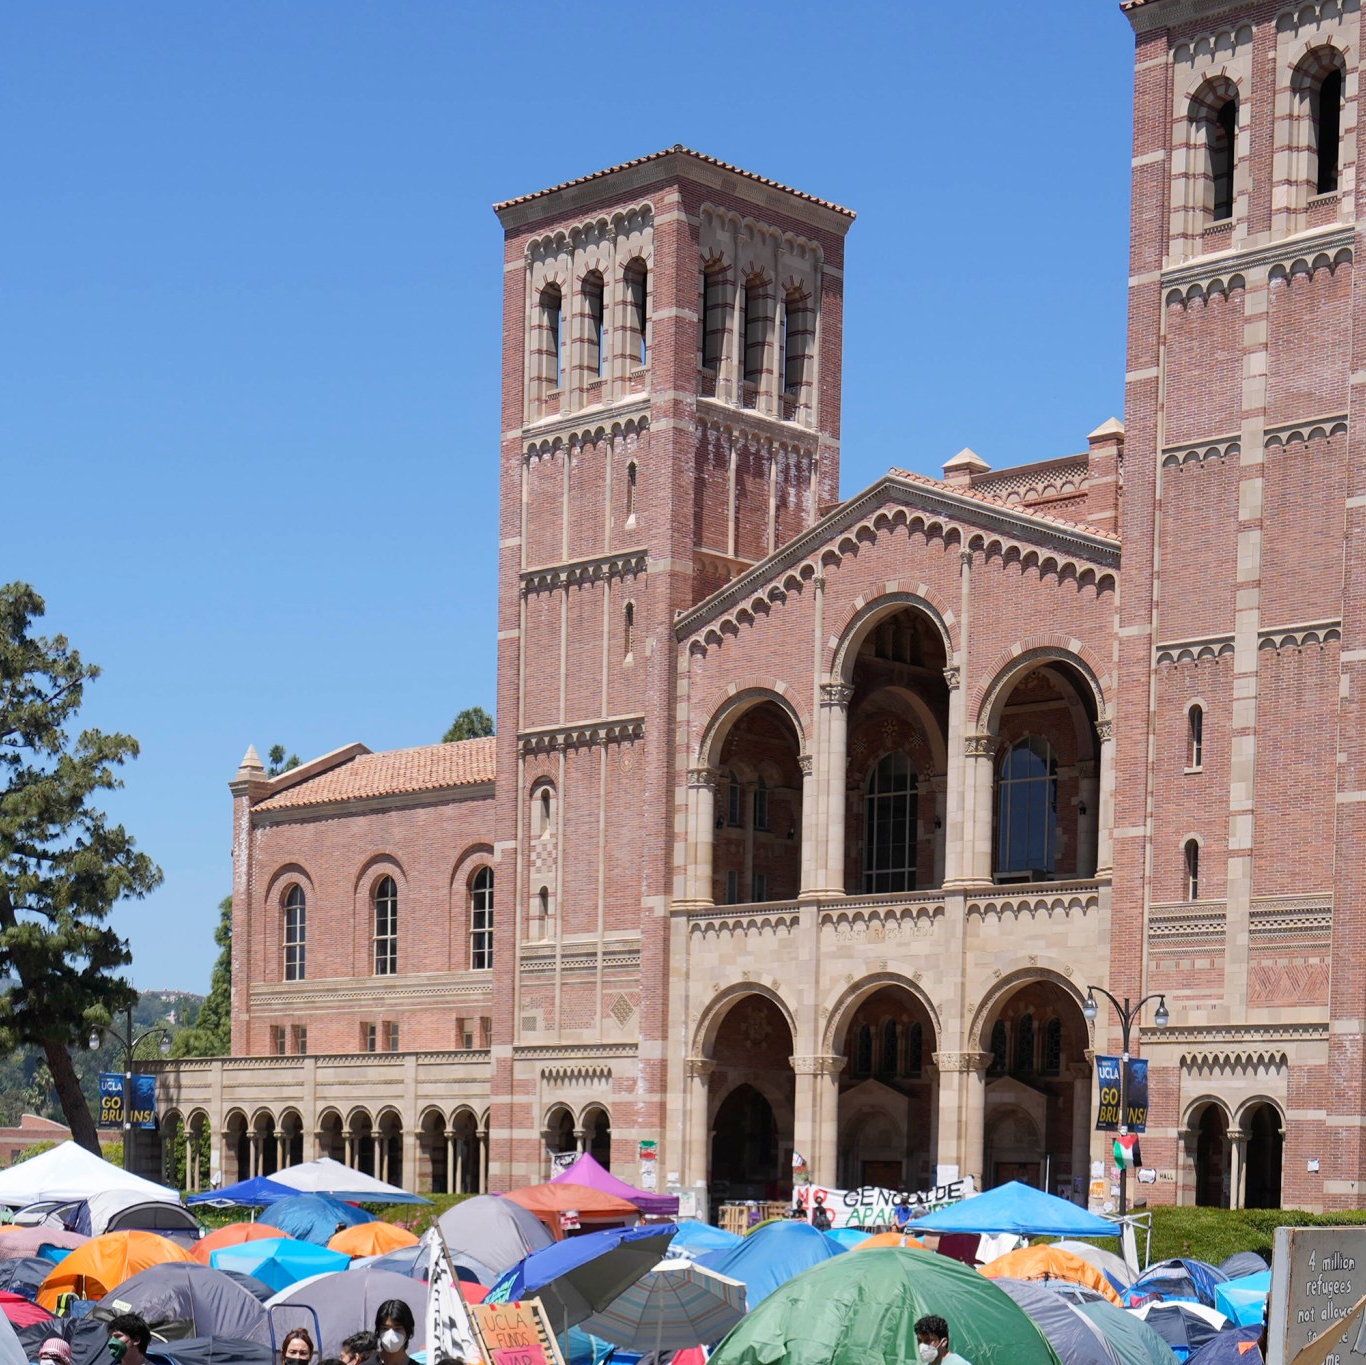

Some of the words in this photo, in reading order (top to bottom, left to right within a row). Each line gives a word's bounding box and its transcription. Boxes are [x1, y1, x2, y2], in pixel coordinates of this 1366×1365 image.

[1098, 1067, 1120, 1080] UCLA
[101, 1082, 123, 1091] UCLA
[102, 1096, 122, 1109] GO
[1101, 1088, 1118, 1105] GO
[1308, 1249, 1316, 1272] 4
[1322, 1251, 1355, 1272] million
[1306, 1273, 1352, 1299] refugees
[484, 1312, 528, 1332] UCLA
[1297, 1307, 1315, 1324] not
[496, 1332, 531, 1349] FUNDS
